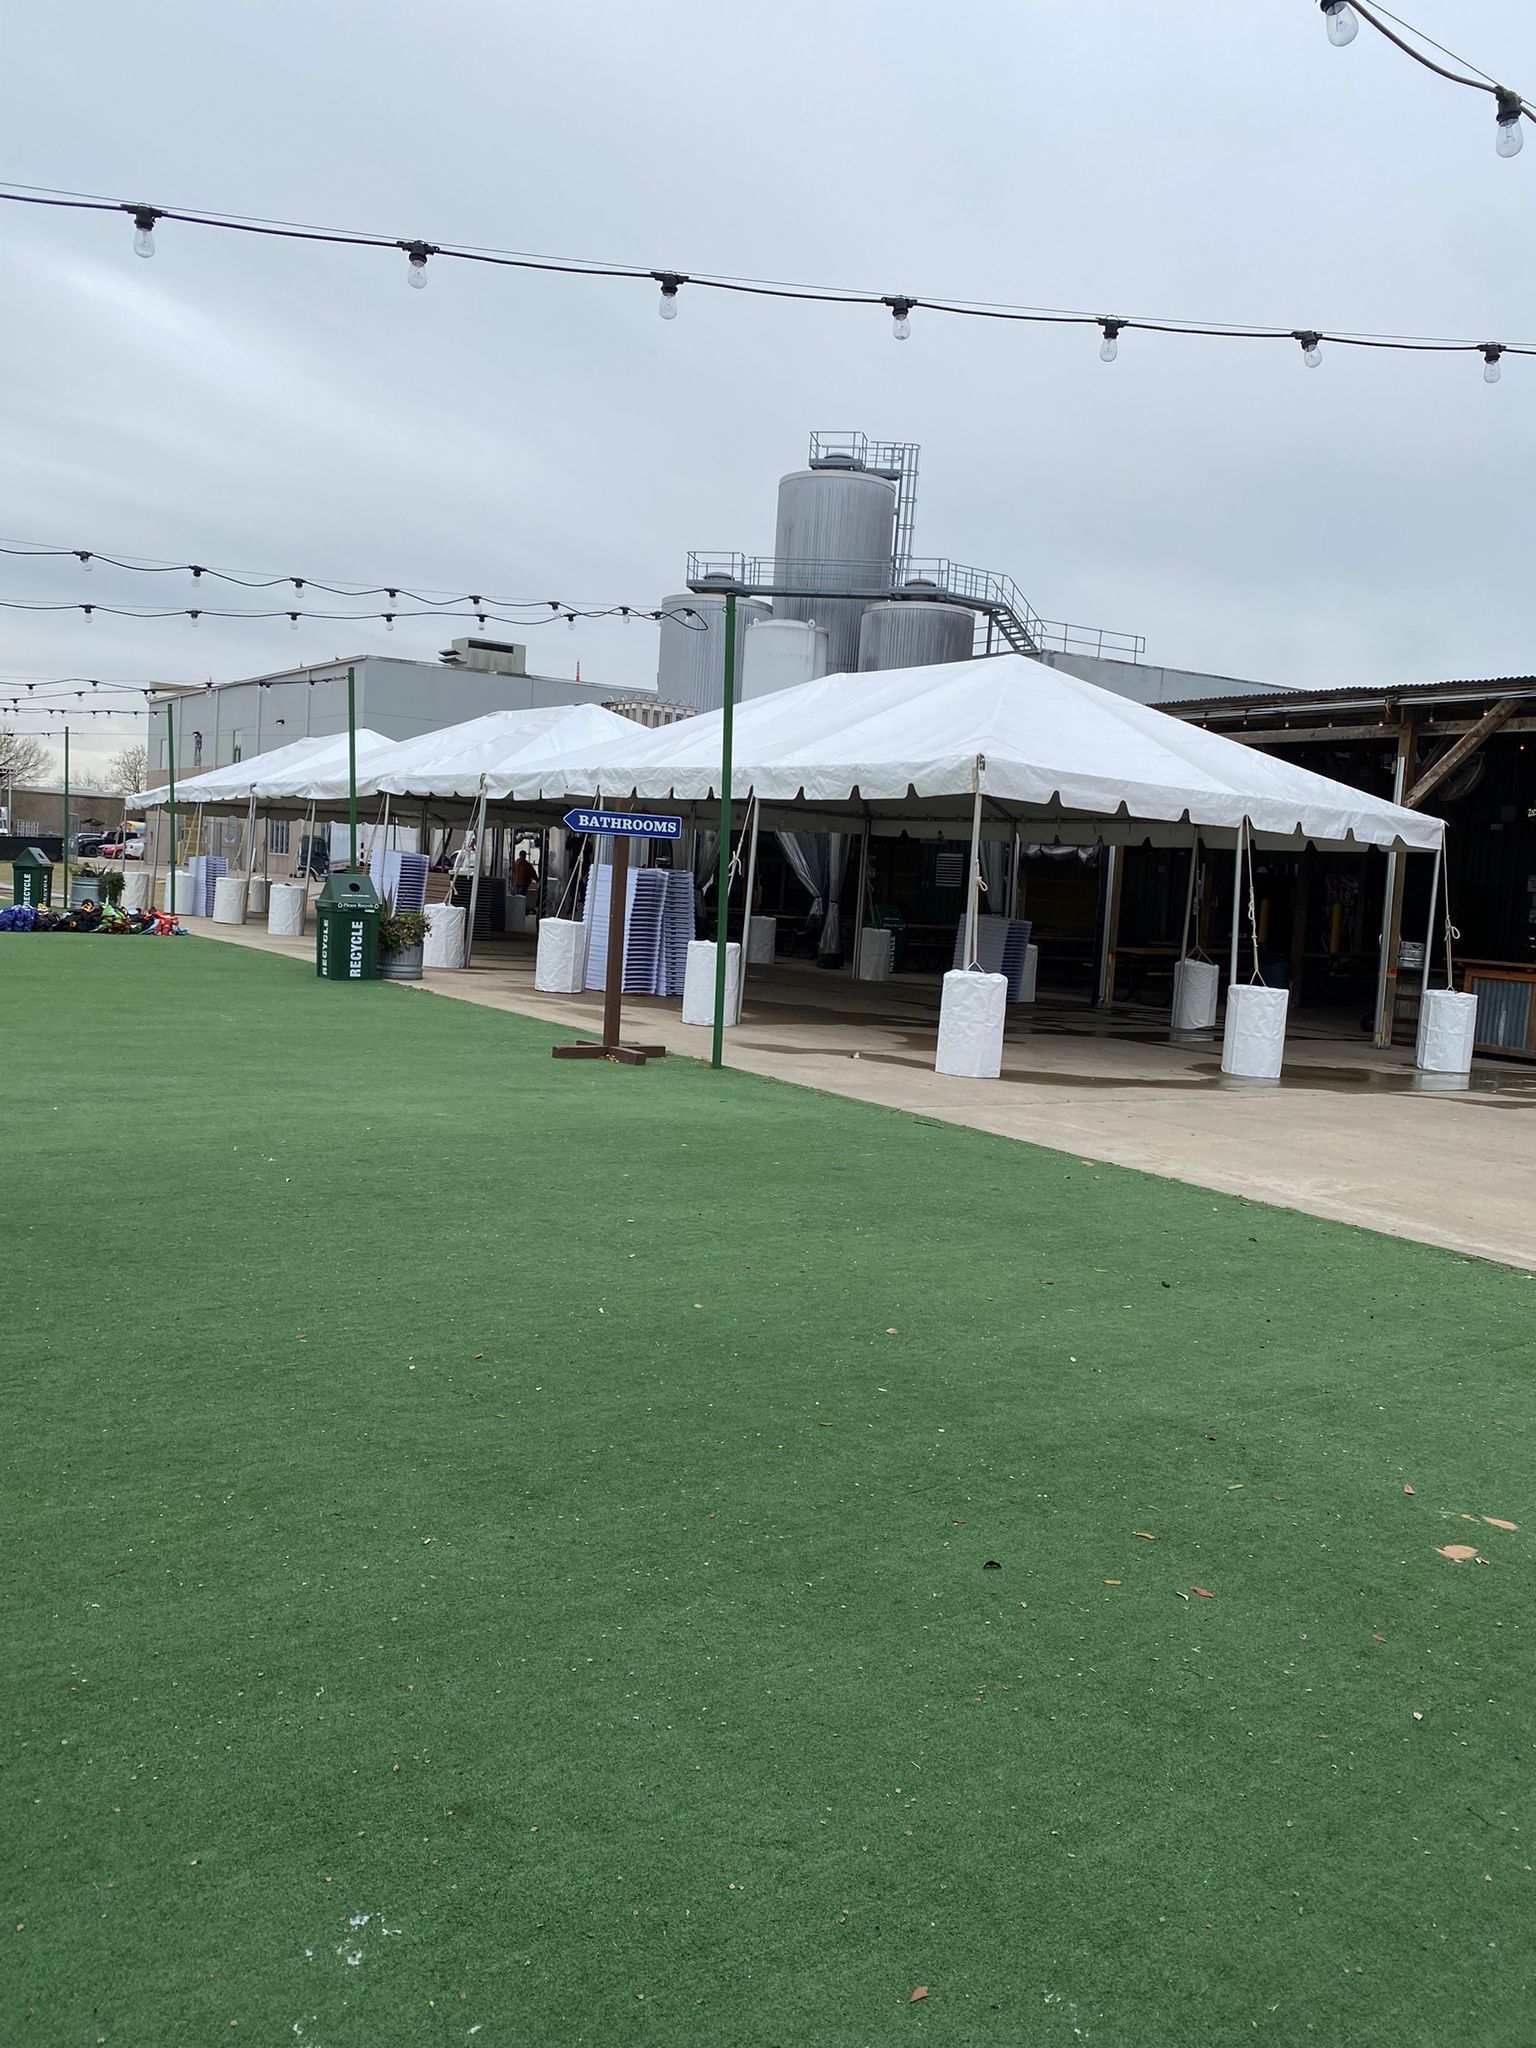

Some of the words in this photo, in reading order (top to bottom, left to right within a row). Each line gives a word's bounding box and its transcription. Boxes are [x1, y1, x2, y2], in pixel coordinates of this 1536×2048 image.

[578, 815, 677, 833] BATHROOMS
[23, 873, 31, 907] RECYCLE
[349, 921, 363, 978] RECYCLE
